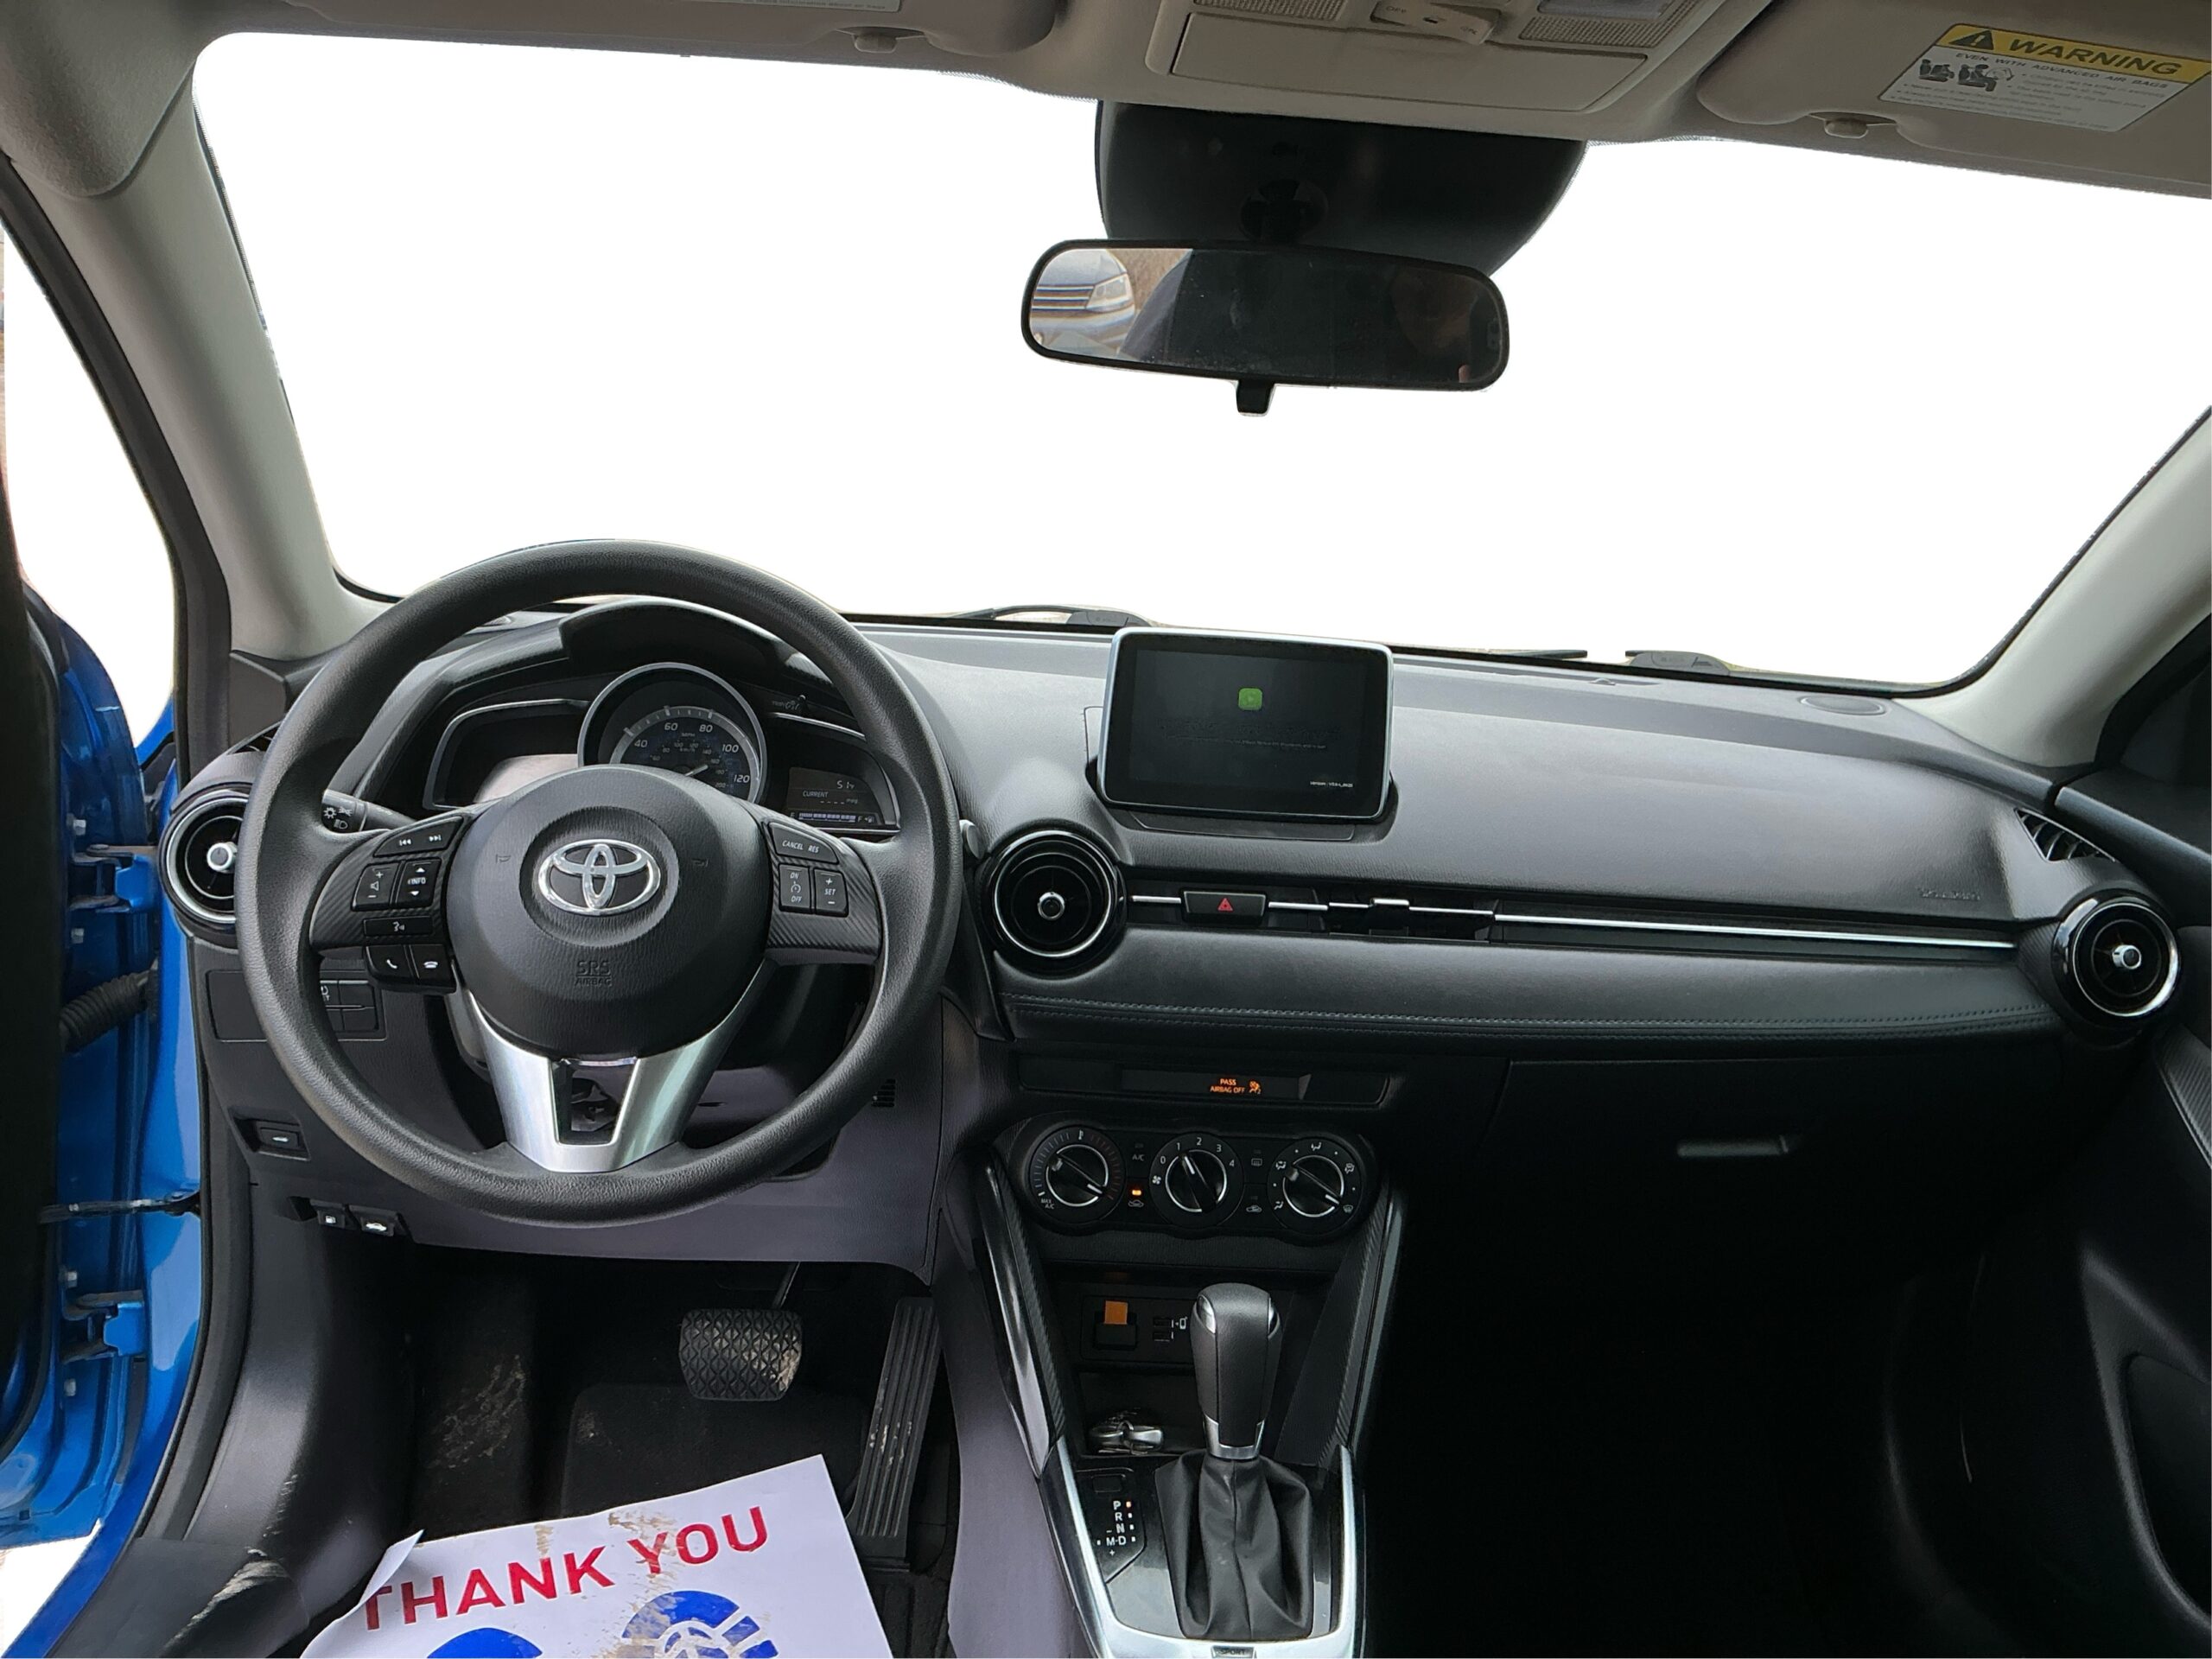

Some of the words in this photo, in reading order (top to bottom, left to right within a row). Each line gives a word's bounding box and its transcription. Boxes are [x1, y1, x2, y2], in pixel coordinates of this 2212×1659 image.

[2010, 39, 2182, 74] WARNING
[1956, 53, 1989, 61] EVEN
[2032, 65, 2100, 78] ADVANCED
[2132, 79, 2169, 89] BAGS
[664, 722, 678, 731] 60
[699, 724, 713, 733] 80
[634, 740, 648, 748] 40
[721, 744, 739, 753] 100
[734, 774, 750, 784] 120
[802, 790, 829, 798] CURRENT
[782, 840, 804, 850] CANCEL
[808, 844, 819, 853] RES
[577, 960, 611, 976] SRS
[574, 977, 613, 988] AIRBAG
[1197, 1137, 1202, 1146] 2
[1217, 1144, 1222, 1153] 3
[1160, 1155, 1166, 1164] 0
[1113, 1500, 1122, 1510] P
[1115, 1512, 1123, 1521] R
[1116, 1522, 1125, 1533] N
[365, 1545, 614, 1630] THANK
[627, 1506, 768, 1574] YOU
